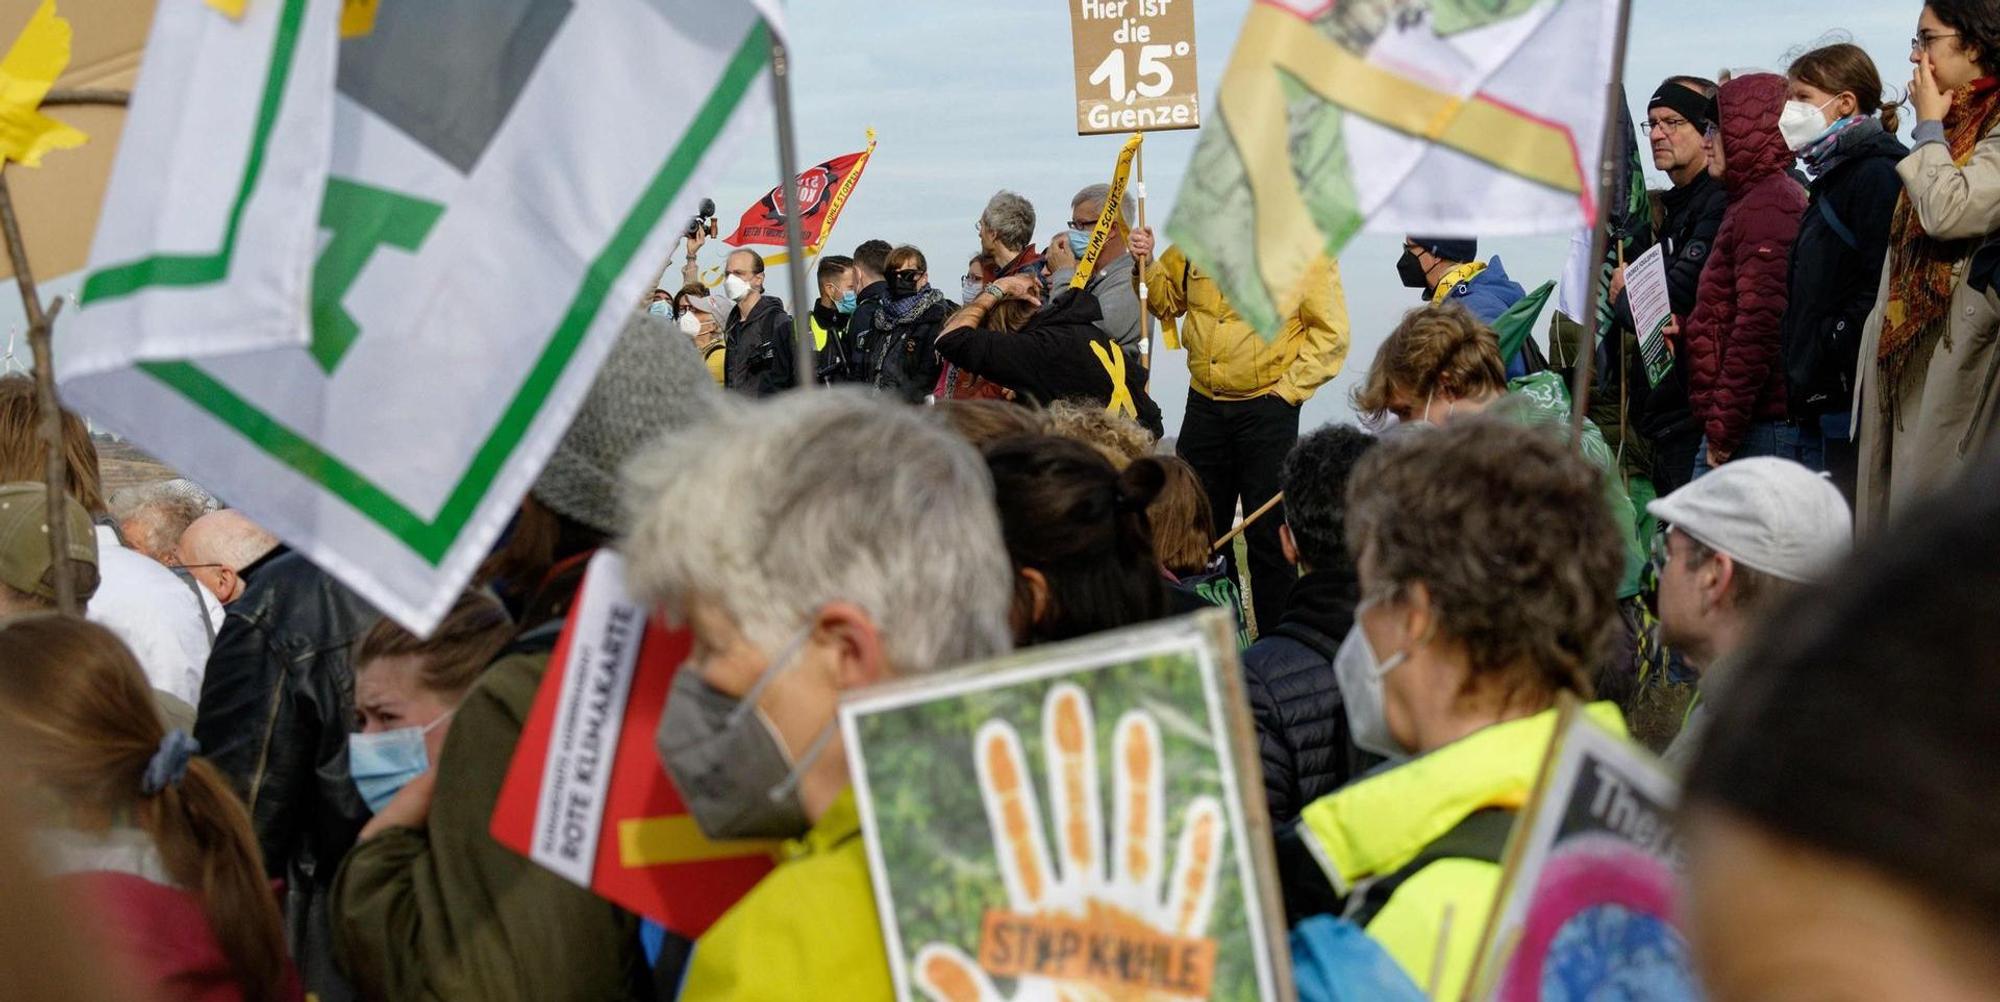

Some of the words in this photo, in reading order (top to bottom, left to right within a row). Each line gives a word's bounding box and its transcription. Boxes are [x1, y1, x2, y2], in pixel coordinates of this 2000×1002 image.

[1082, 0, 1128, 19] Hier
[1113, 17, 1151, 43] die
[1088, 104, 1189, 129] Grenze
[1086, 230, 1105, 263] KLIMA
[560, 794, 591, 861] ROTE
[578, 606, 634, 786] KLIMAKARTE
